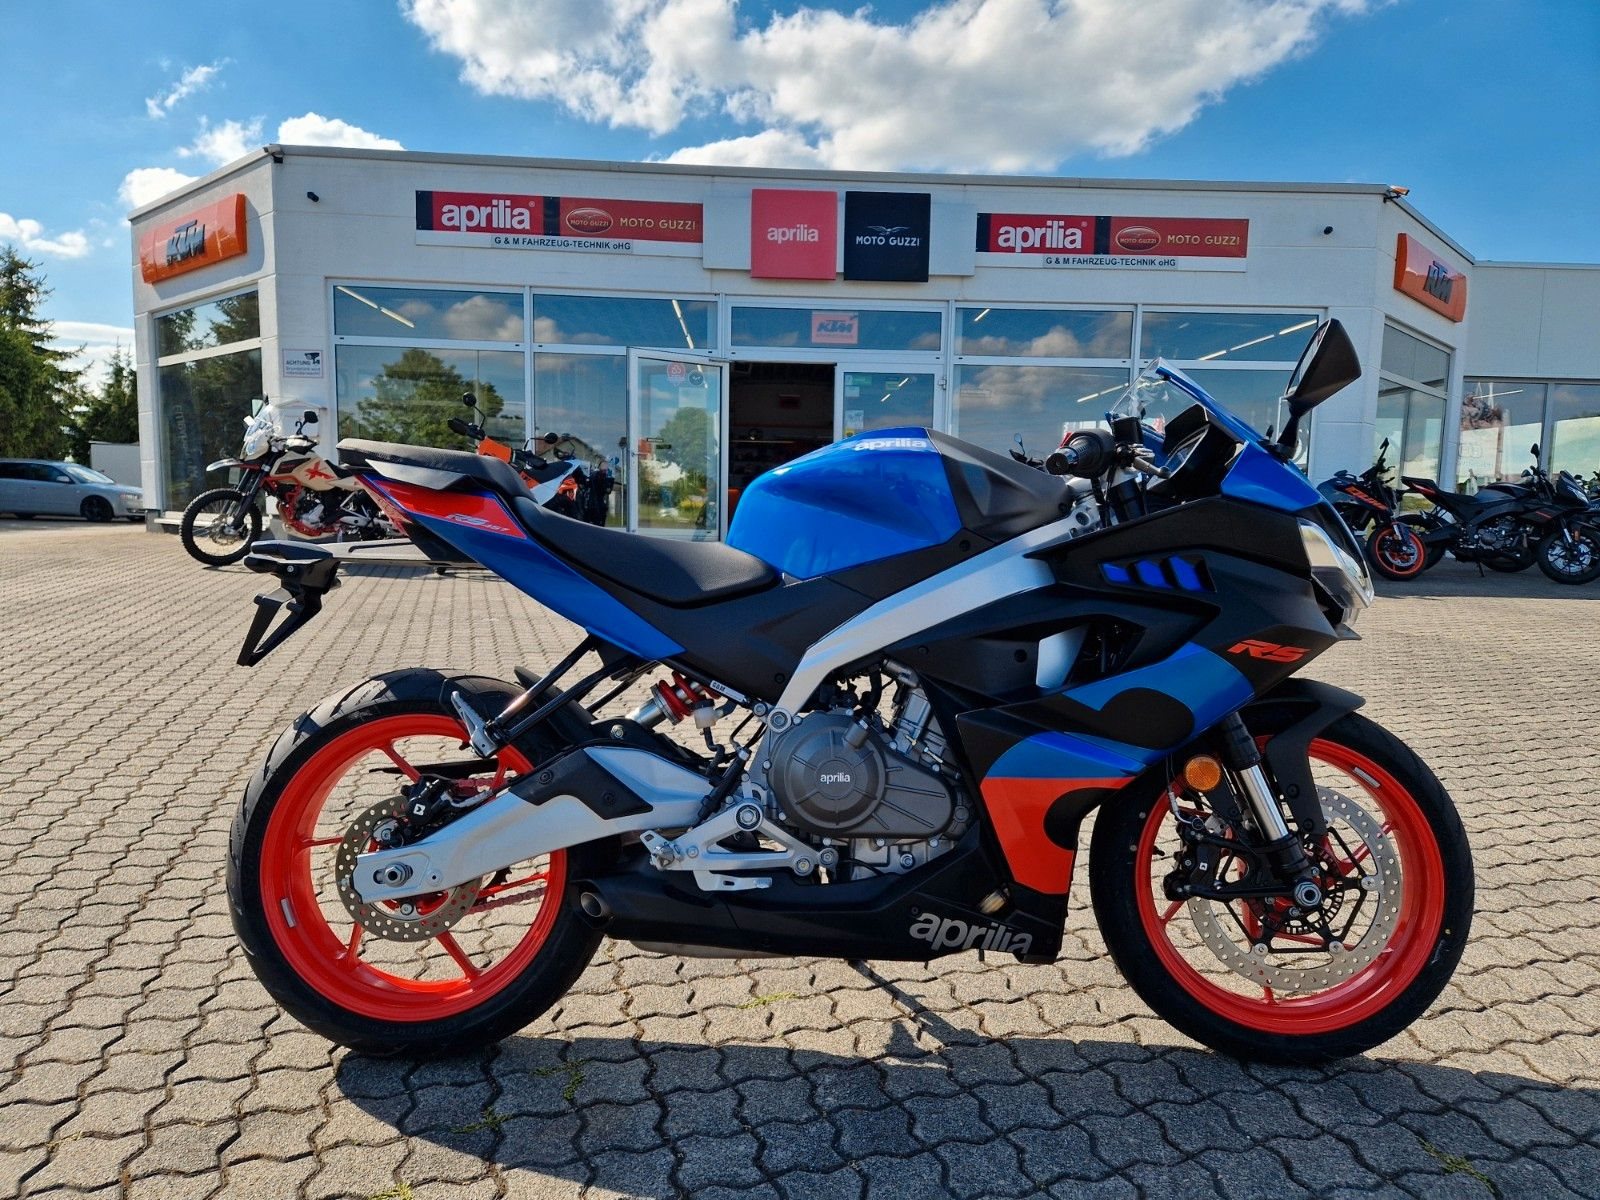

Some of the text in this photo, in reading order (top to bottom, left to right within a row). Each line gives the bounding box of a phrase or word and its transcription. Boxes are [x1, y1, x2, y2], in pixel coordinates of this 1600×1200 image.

[441, 199, 530, 232] aprilia
[570, 218, 588, 226] MOTO
[620, 218, 696, 230] MOTO GUZZI
[767, 224, 819, 244] aprilia
[998, 221, 1082, 252] aprilia
[1168, 234, 1240, 246] MOTO GUZZI
[166, 219, 206, 267] KTM
[494, 237, 502, 245] G
[522, 238, 610, 249] FAHRZEUG-TECHNIK
[613, 242, 631, 250] oHG
[856, 235, 920, 247] MOTO GUZZI
[1046, 257, 1053, 265] G
[1063, 258, 1070, 266] M
[1072, 258, 1156, 266] FAHRZEUG-TECHNIK
[817, 320, 853, 333] KTM
[854, 438, 926, 450] aprilia
[1227, 640, 1311, 663] RS
[820, 773, 850, 784] aprilia
[908, 912, 1033, 955] aprilia
